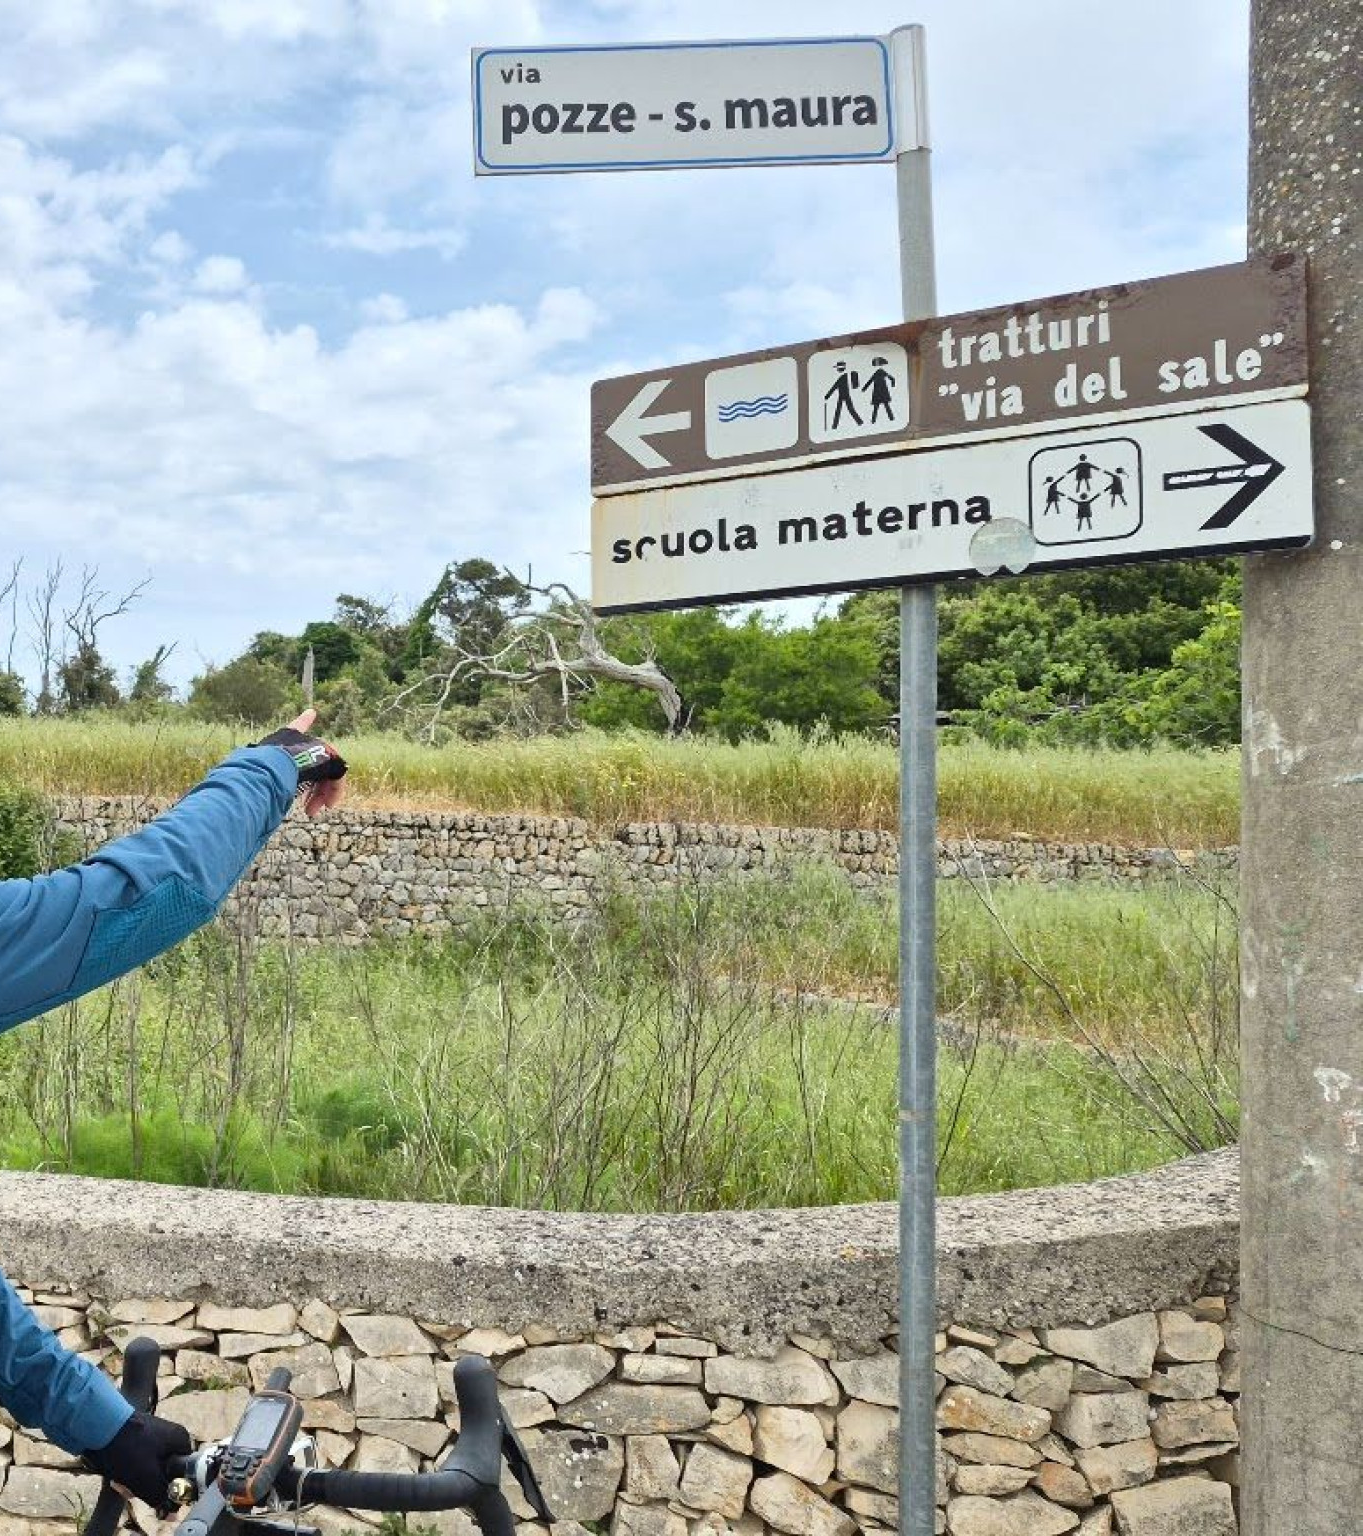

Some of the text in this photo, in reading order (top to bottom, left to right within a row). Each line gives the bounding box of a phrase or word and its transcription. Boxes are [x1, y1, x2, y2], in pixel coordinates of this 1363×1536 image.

[500, 62, 542, 84] via
[501, 94, 878, 145] pozze - s. maura
[938, 299, 1111, 369] tratturi
[1054, 355, 1128, 408] del
[611, 495, 992, 564] scuola materna
